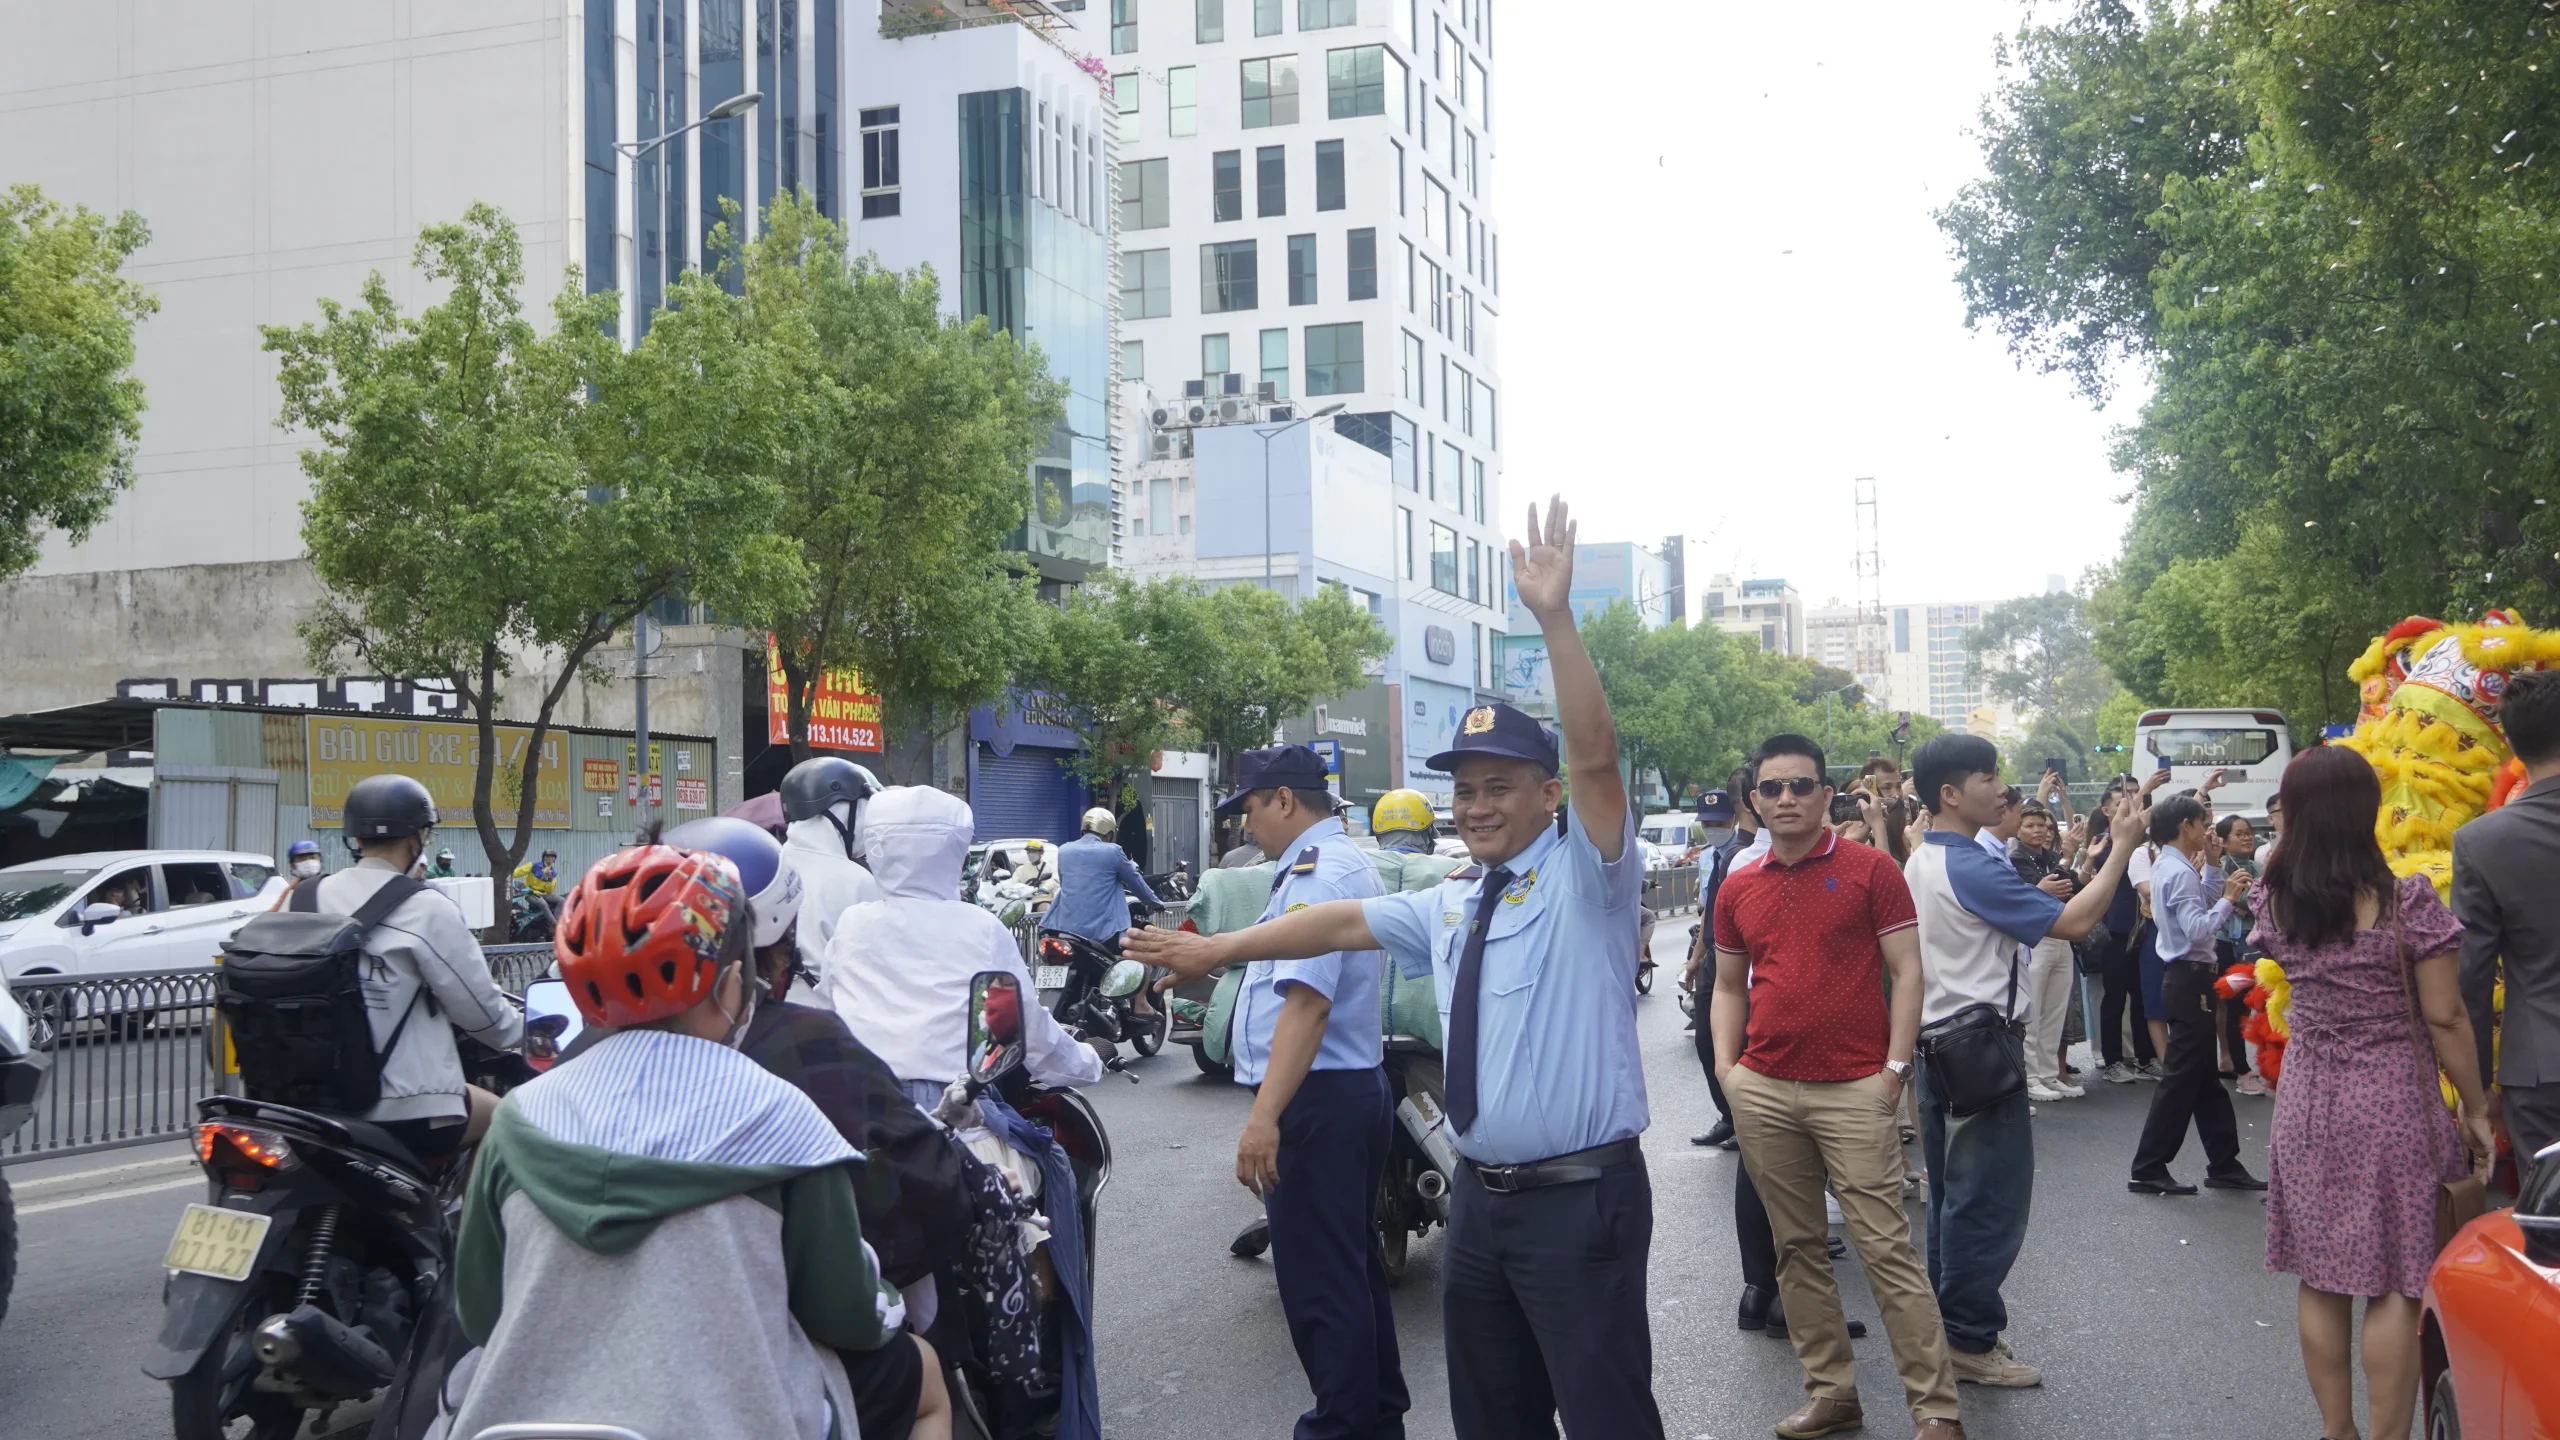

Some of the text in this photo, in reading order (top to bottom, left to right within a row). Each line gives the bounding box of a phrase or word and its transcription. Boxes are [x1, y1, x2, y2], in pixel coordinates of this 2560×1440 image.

[818, 694, 841, 719] VĂN
[1328, 717, 1367, 736] namviet
[319, 723, 368, 763] BÃI
[375, 725, 422, 764] GIỮ
[427, 732, 463, 767] XE
[454, 778, 465, 799] &
